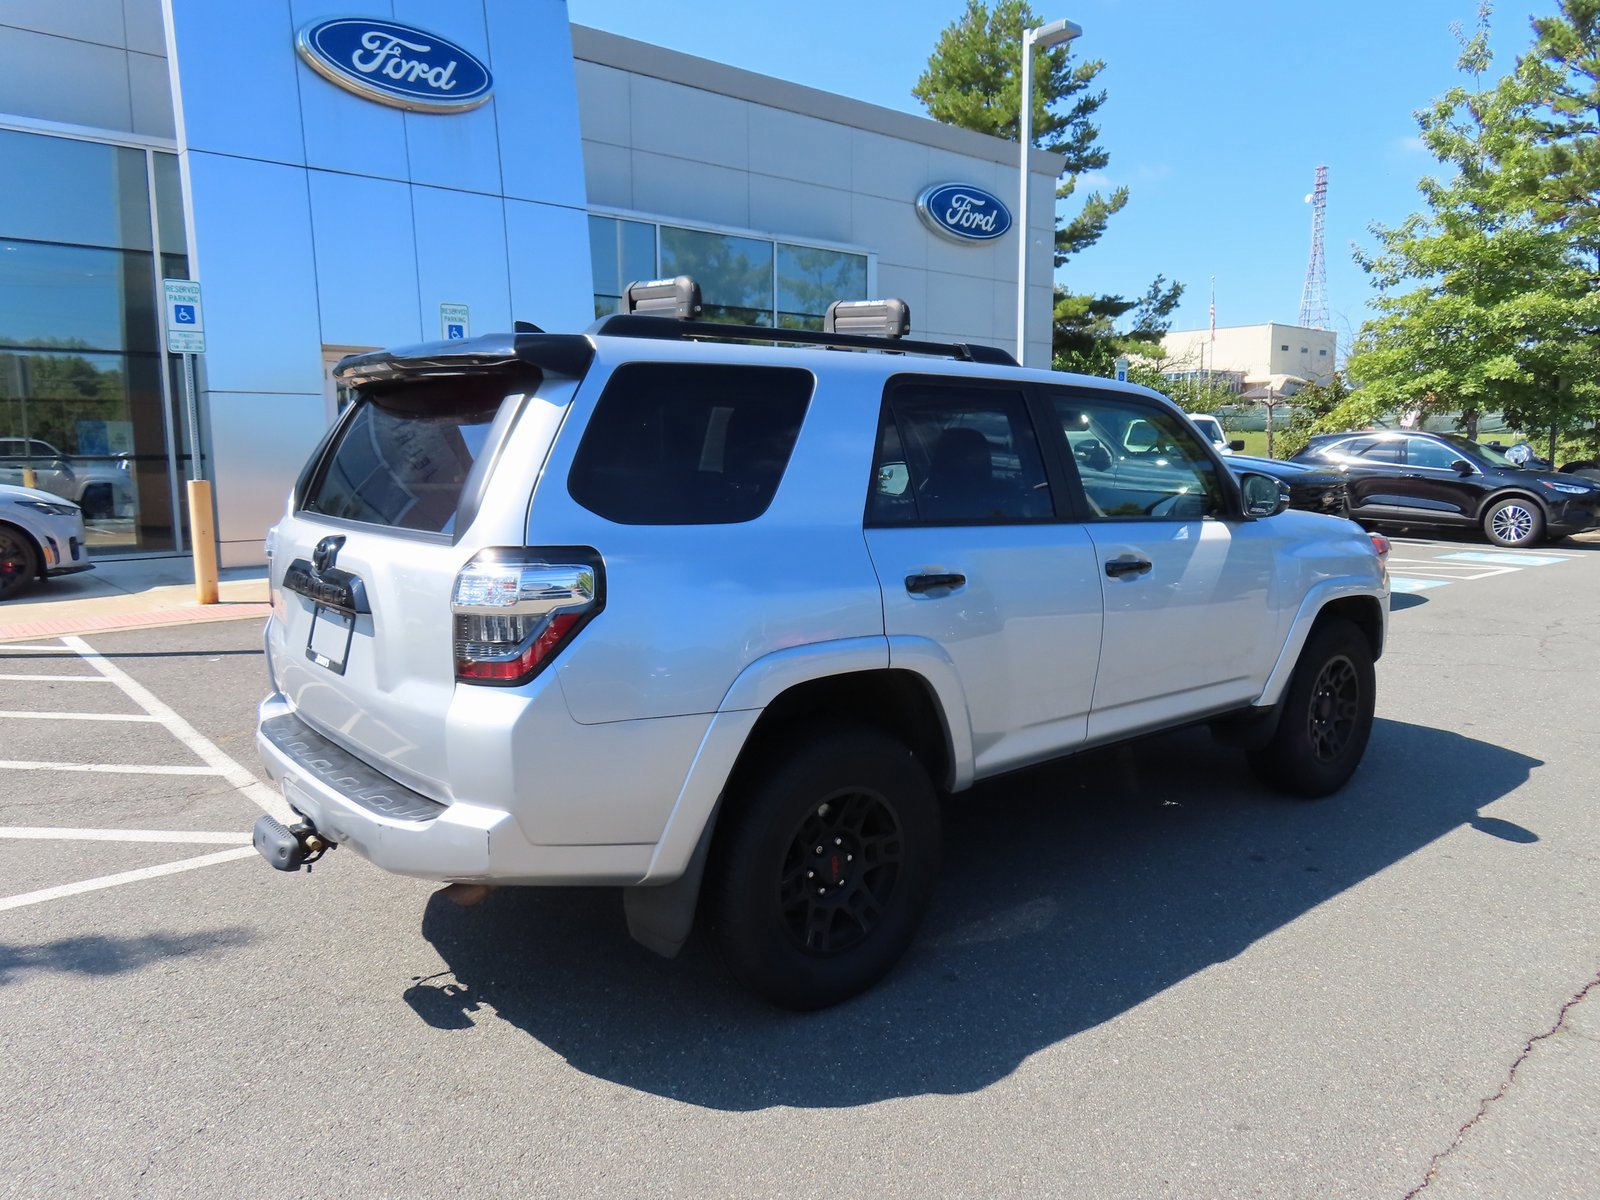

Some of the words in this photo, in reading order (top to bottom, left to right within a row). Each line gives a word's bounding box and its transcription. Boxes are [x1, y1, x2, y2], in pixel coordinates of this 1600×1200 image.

[351, 31, 457, 90] Ford
[946, 194, 998, 232] Ford
[165, 284, 199, 294] RESERVED
[169, 294, 198, 303] PARKING
[441, 308, 467, 316] RESERVED
